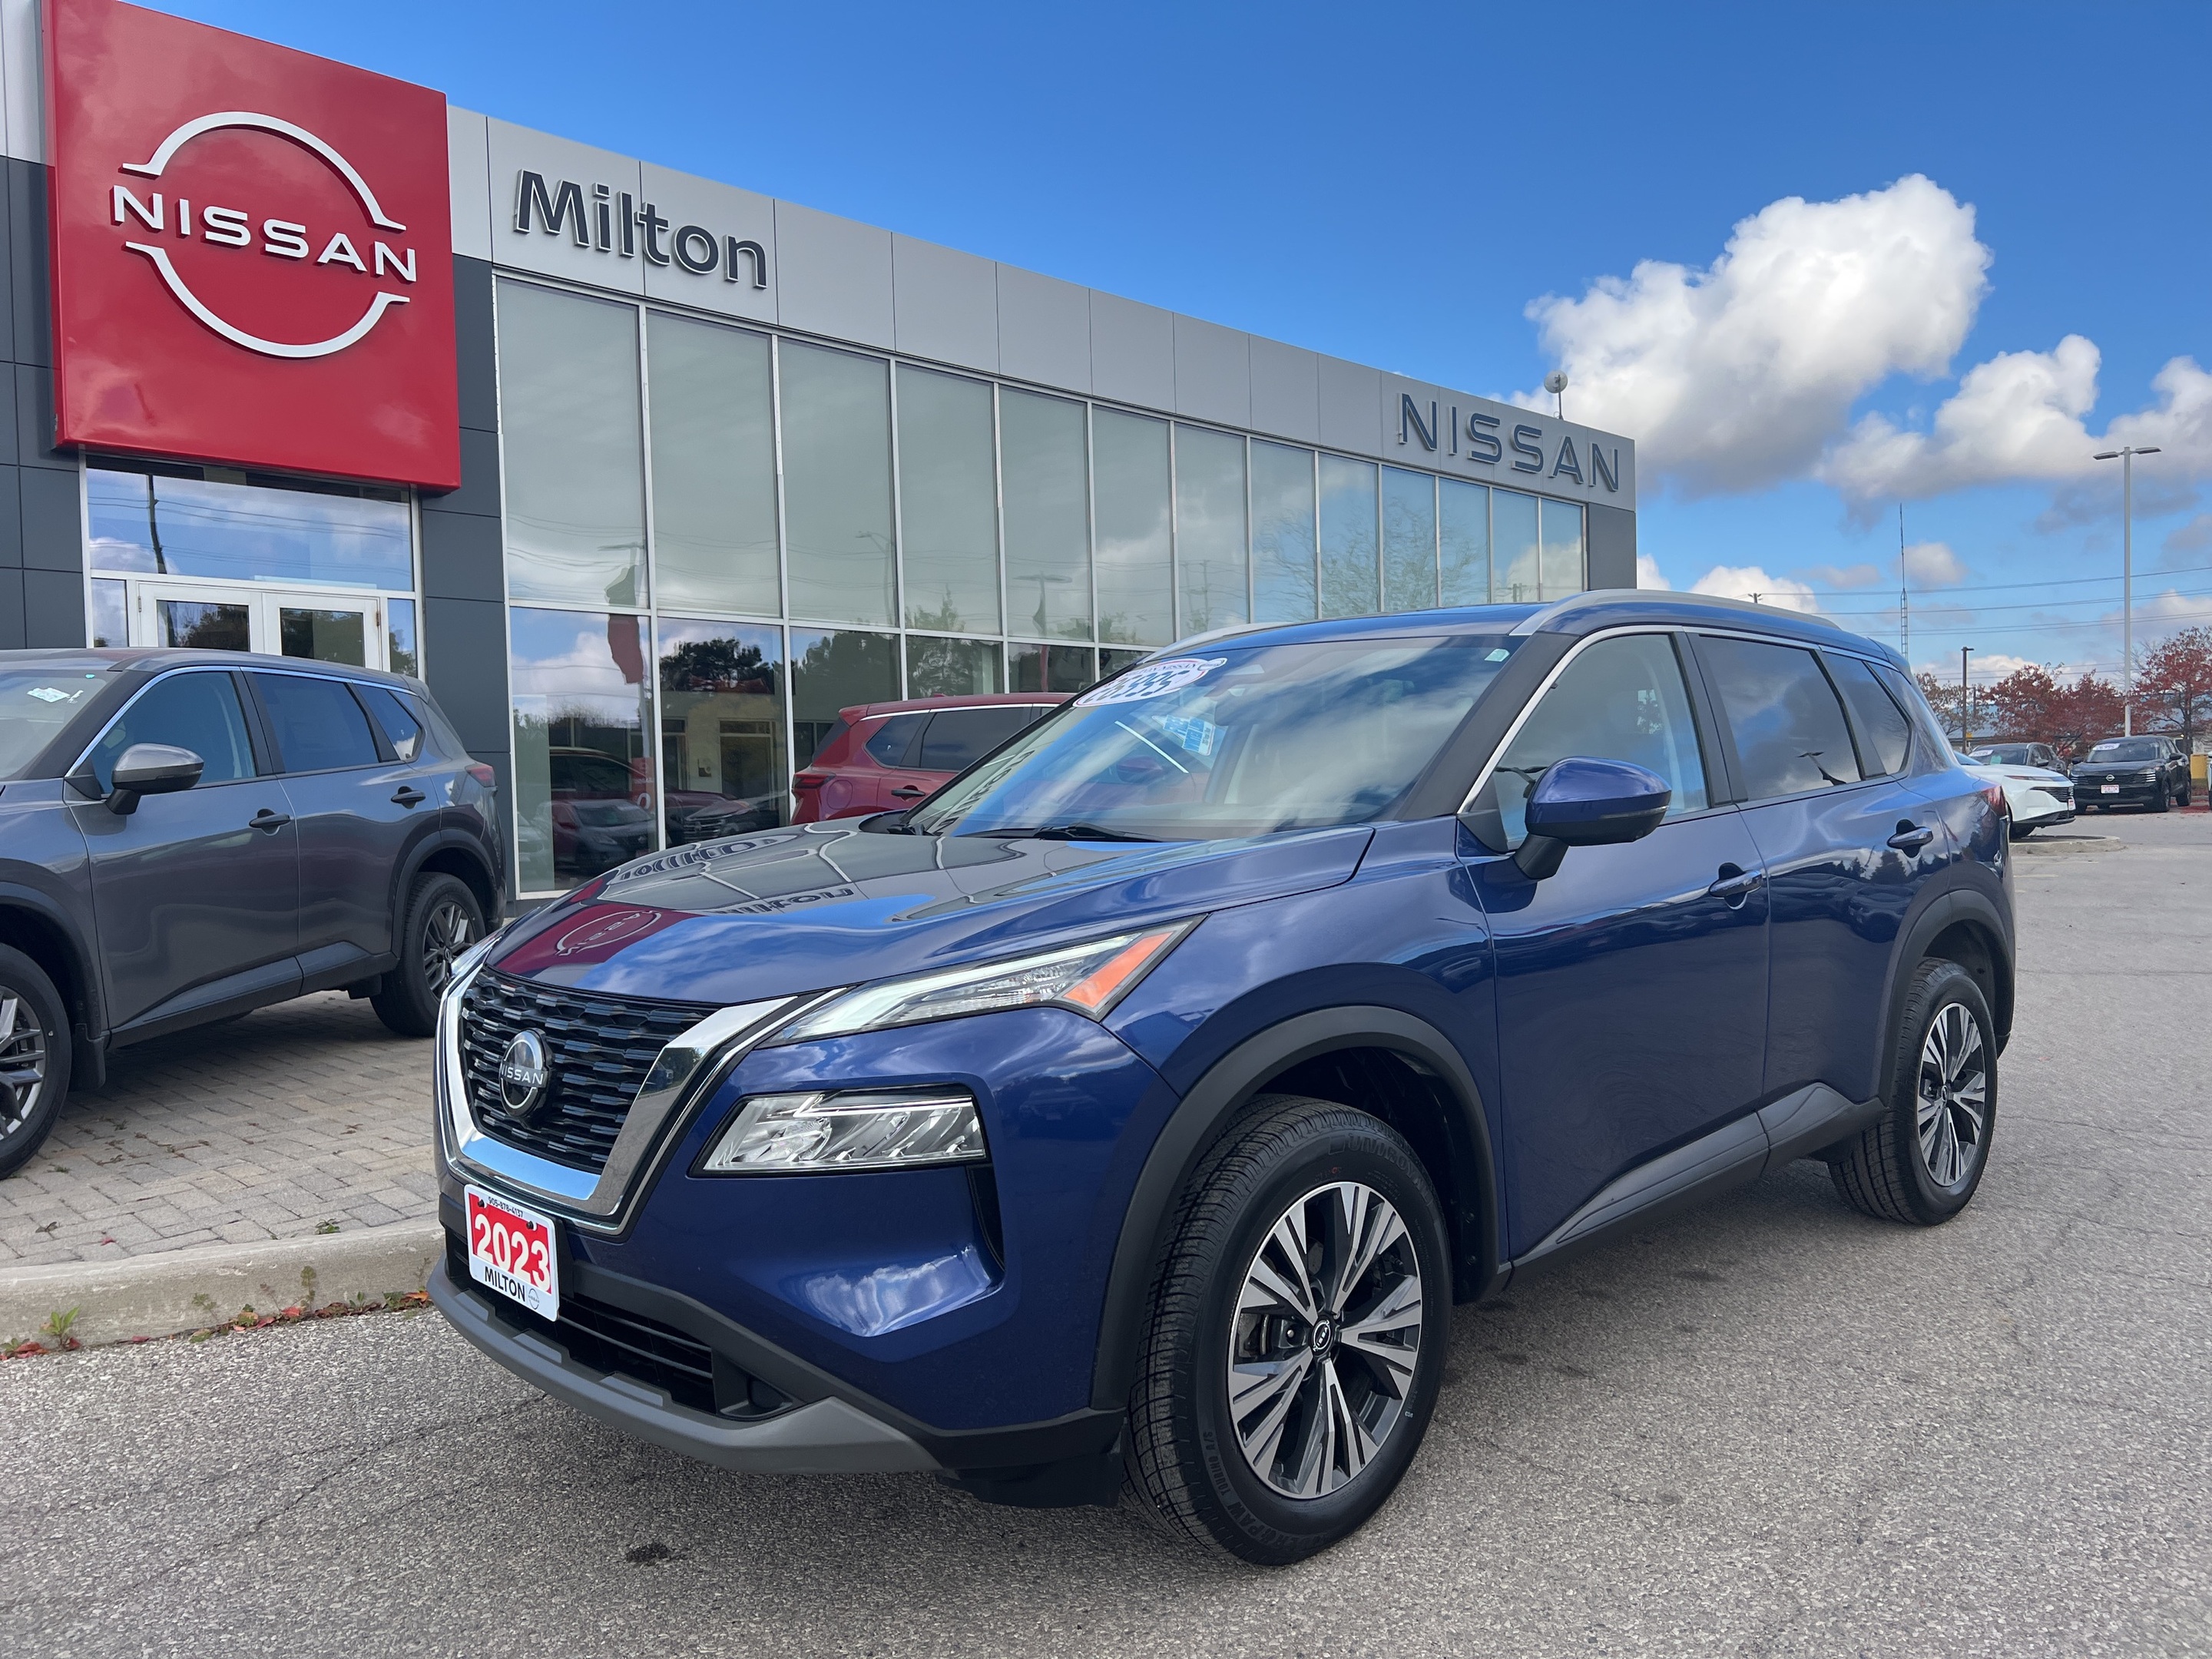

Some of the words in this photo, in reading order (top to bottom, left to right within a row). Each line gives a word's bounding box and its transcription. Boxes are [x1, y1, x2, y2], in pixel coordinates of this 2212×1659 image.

[112, 184, 418, 283] NISSAN
[513, 168, 768, 290] Milton
[1398, 392, 1620, 492] NISSAN
[500, 1064, 544, 1085] NISSAN
[475, 1214, 551, 1292] 2023
[485, 1267, 526, 1303] MILTON
